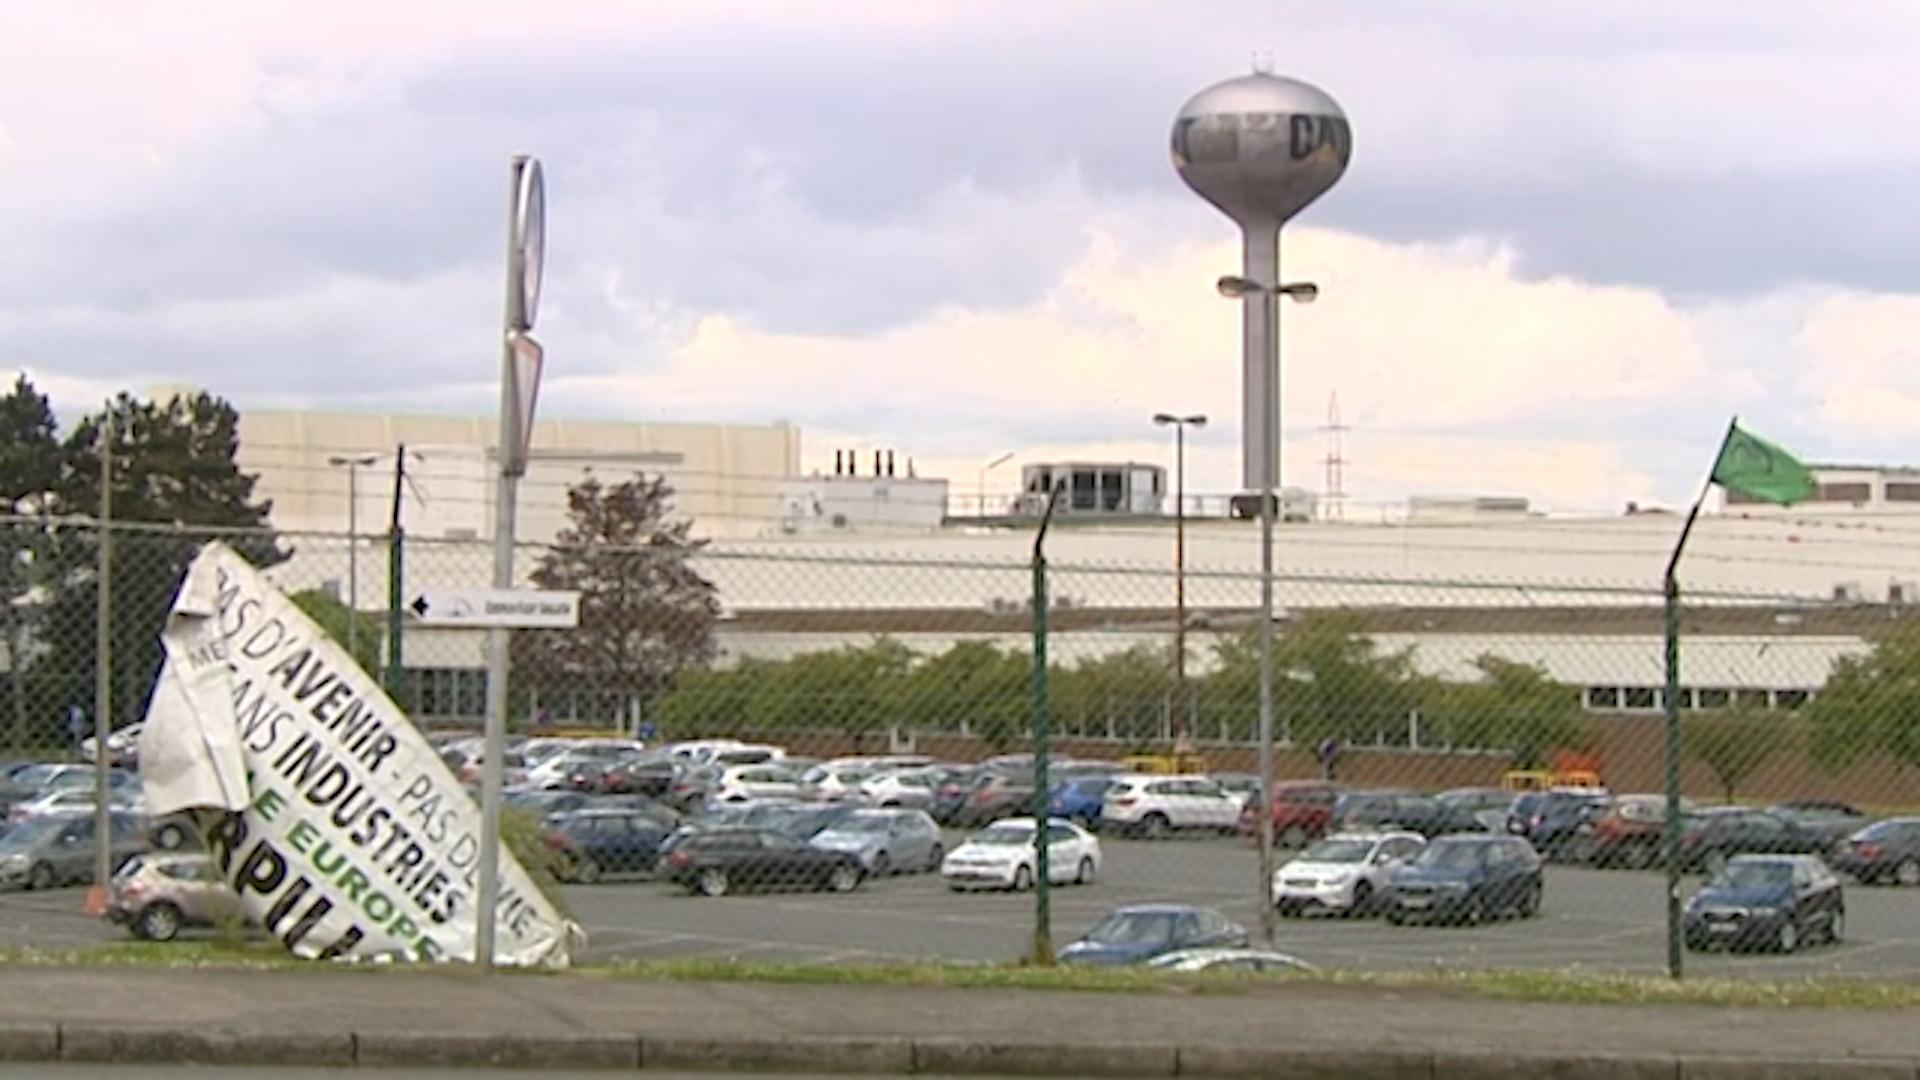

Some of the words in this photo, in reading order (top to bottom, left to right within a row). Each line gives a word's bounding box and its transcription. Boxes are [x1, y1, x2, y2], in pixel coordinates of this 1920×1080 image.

[228, 663, 296, 754] ANS
[271, 731, 466, 925] INDUSTRIES
[241, 617, 396, 773] D'AVENIR
[398, 774, 459, 844] PAS
